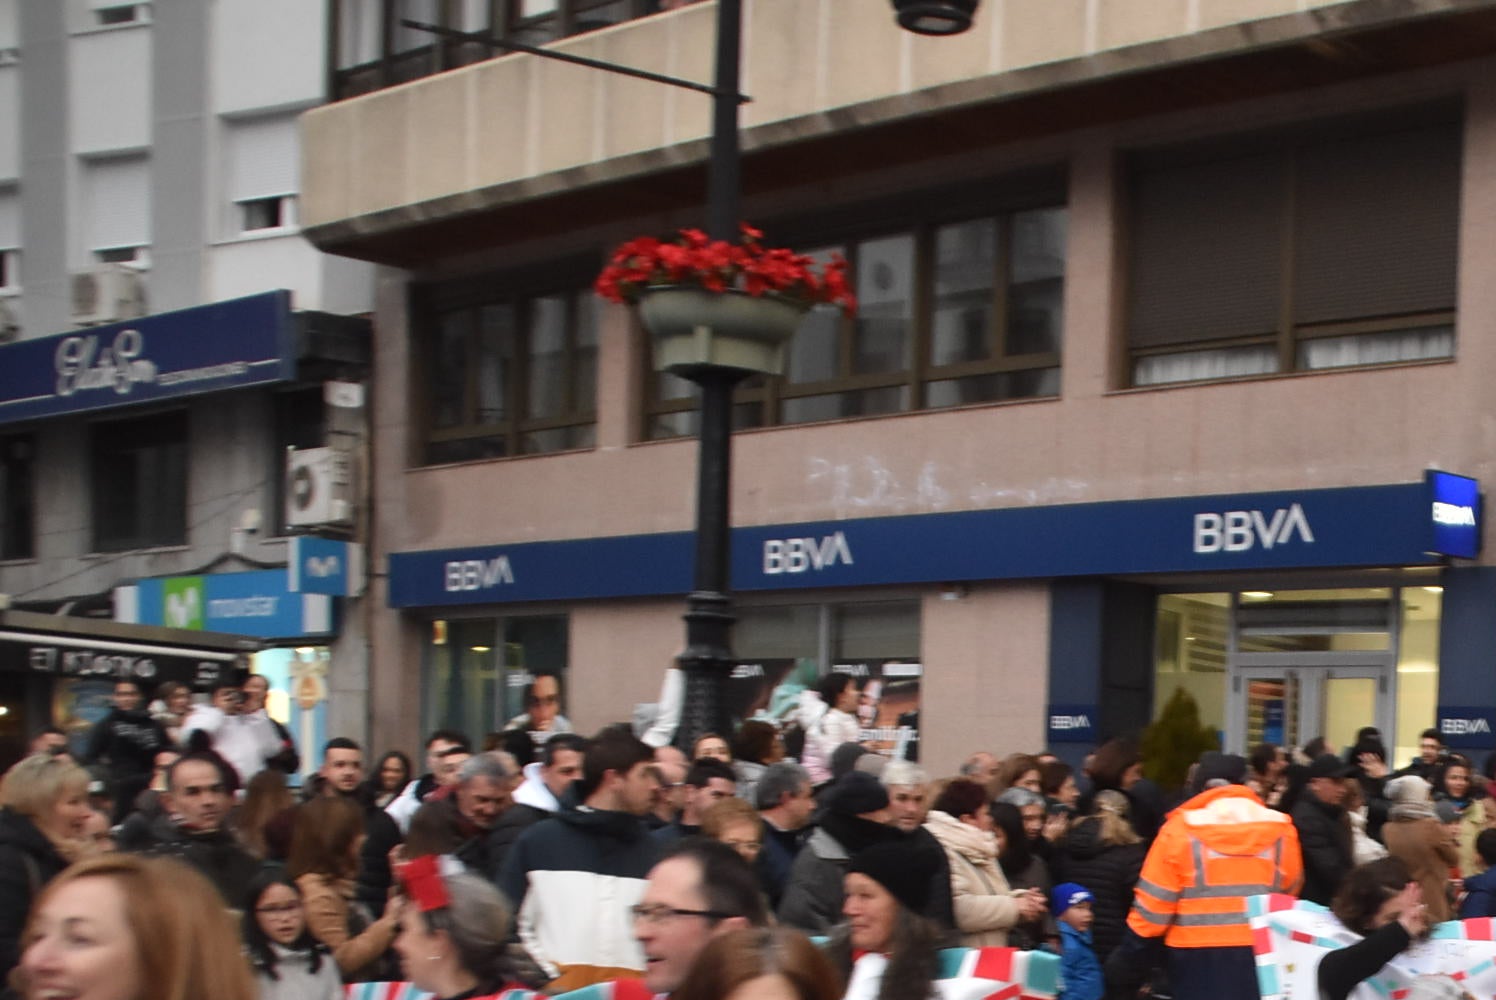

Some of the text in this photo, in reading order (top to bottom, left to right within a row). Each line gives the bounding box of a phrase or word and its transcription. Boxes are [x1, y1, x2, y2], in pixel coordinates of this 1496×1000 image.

[1193, 503, 1315, 553] BBVA
[1432, 502, 1476, 526] BBVA
[763, 531, 853, 574] BBVA
[446, 555, 514, 592] BBVA
[1441, 718, 1491, 734] BBVA
